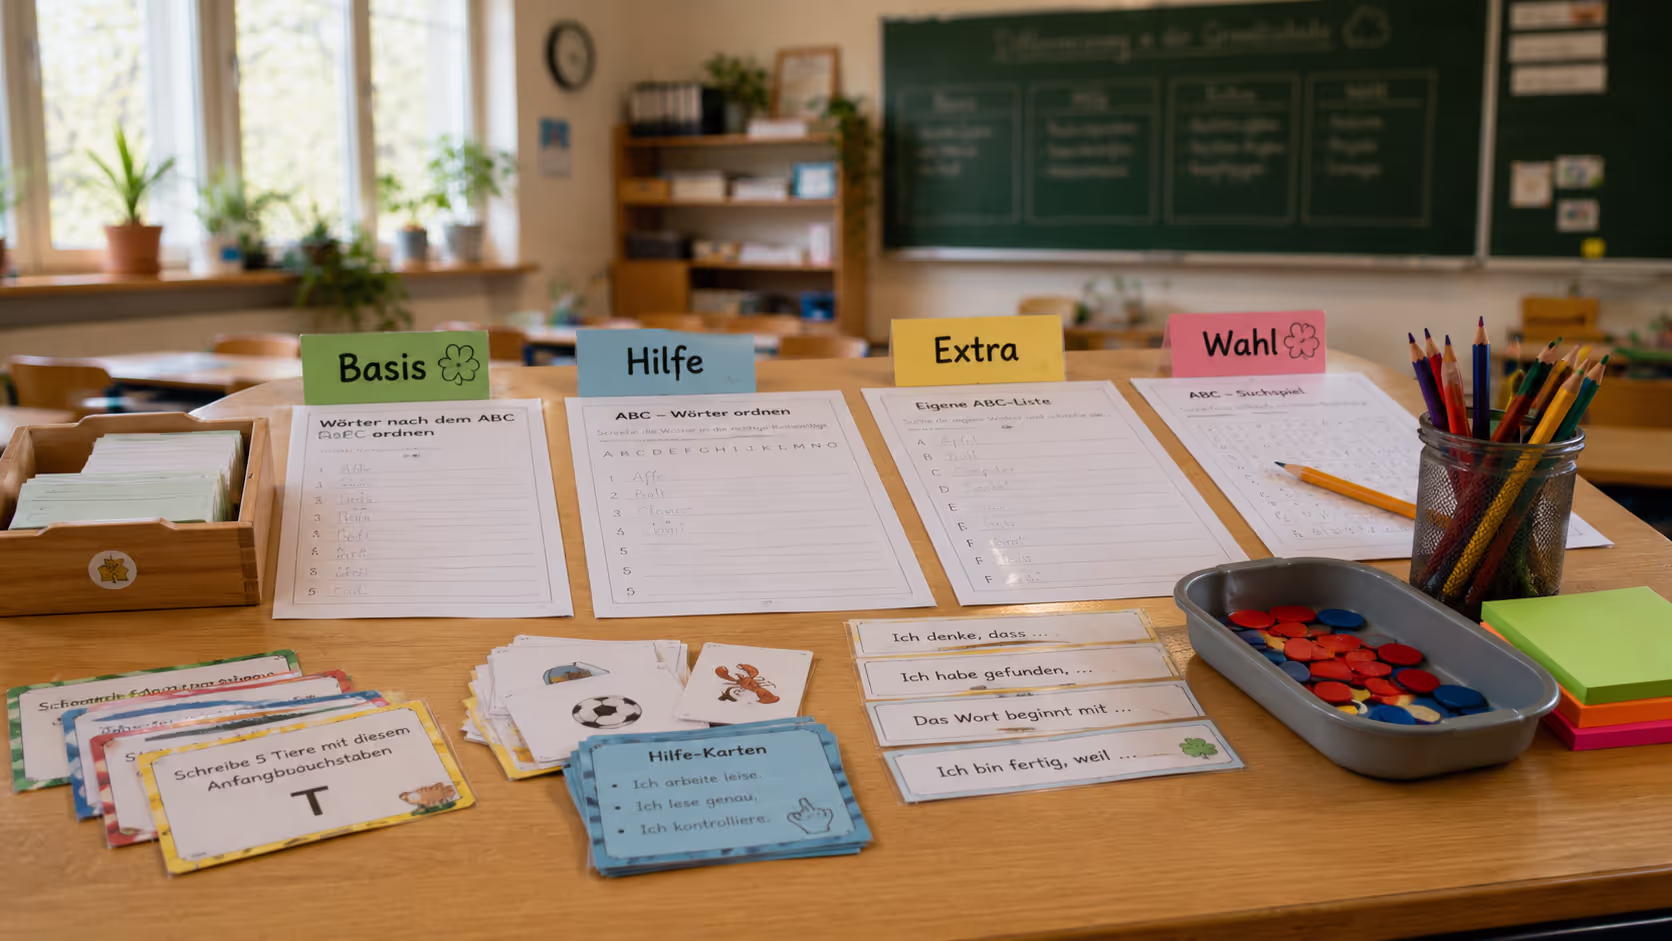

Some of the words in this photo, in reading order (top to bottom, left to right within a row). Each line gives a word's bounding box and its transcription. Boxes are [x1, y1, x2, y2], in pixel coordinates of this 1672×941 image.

[1202, 327, 1279, 357] Wahl
[935, 336, 1020, 364] Extra
[338, 352, 427, 384] Basis
[626, 344, 704, 381] Hilfe
[1189, 390, 1221, 399] ABC
[1235, 386, 1305, 399] Suchspiel
[915, 401, 968, 412] Eigene
[973, 397, 1052, 408] ABC-Liste
[319, 417, 383, 428] Wörter
[387, 416, 429, 426] nach
[434, 415, 472, 425] dem
[477, 413, 516, 424] ABC
[615, 411, 652, 421] ABC
[670, 409, 729, 419] Wörter
[733, 407, 791, 417] ordnen
[372, 428, 436, 438] ordnen
[652, 448, 662, 456] D
[827, 441, 838, 449] O
[923, 453, 933, 461] B
[931, 469, 941, 477] C
[609, 491, 619, 500] 2
[939, 485, 950, 494] D
[613, 509, 622, 518] 3
[892, 632, 921, 643] Ich
[926, 630, 983, 642] denke,
[988, 630, 1027, 639] dass
[901, 671, 930, 683] Ich
[935, 669, 979, 681] habe
[984, 665, 1070, 681] gefunden,
[913, 714, 949, 727] Das
[953, 711, 1001, 724] Wort
[1005, 705, 1073, 723] beginnt
[1078, 703, 1108, 716] mit
[174, 757, 251, 781] Schreibe
[255, 753, 267, 765] 5
[270, 746, 316, 761] Tiere
[321, 737, 349, 752] mit
[353, 727, 411, 745] diesem
[649, 744, 768, 763] Hilfe-Karten
[937, 764, 970, 779] Ich
[975, 760, 1004, 775] bin
[1008, 754, 1069, 772] fertig,
[1072, 749, 1111, 764] weil
[632, 778, 659, 790] Ich
[664, 775, 719, 788] arbeite
[723, 771, 763, 783] leise.
[290, 785, 329, 816] T
[636, 800, 663, 813] Ich
[668, 798, 700, 809] lese
[641, 823, 668, 835] Ich
[673, 814, 771, 833] kontrolliere.
